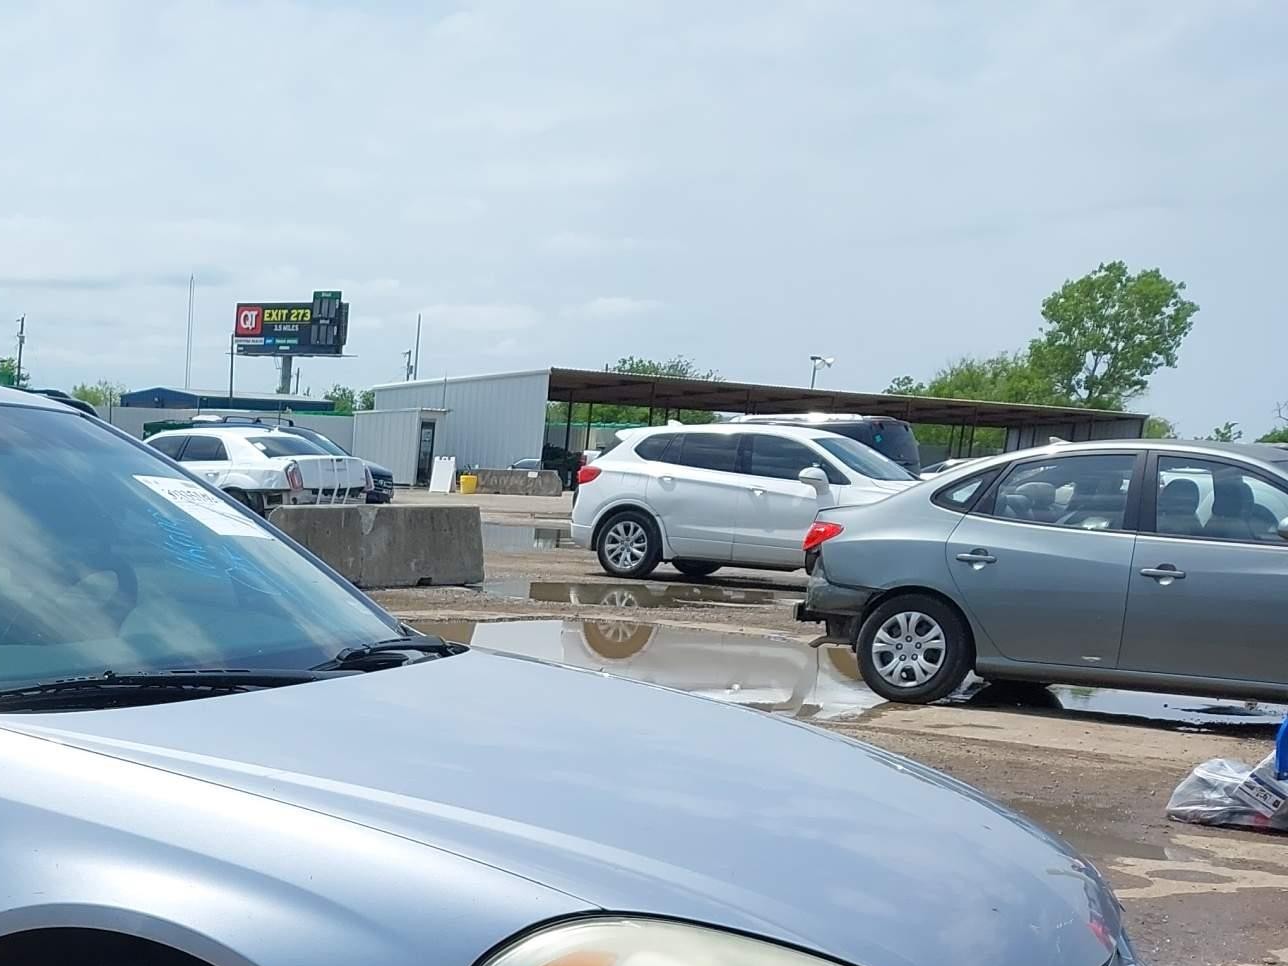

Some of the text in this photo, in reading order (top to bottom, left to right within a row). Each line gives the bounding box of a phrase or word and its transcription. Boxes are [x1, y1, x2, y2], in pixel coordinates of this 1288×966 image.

[240, 309, 258, 330] QT
[264, 309, 311, 321] EXIT 273
